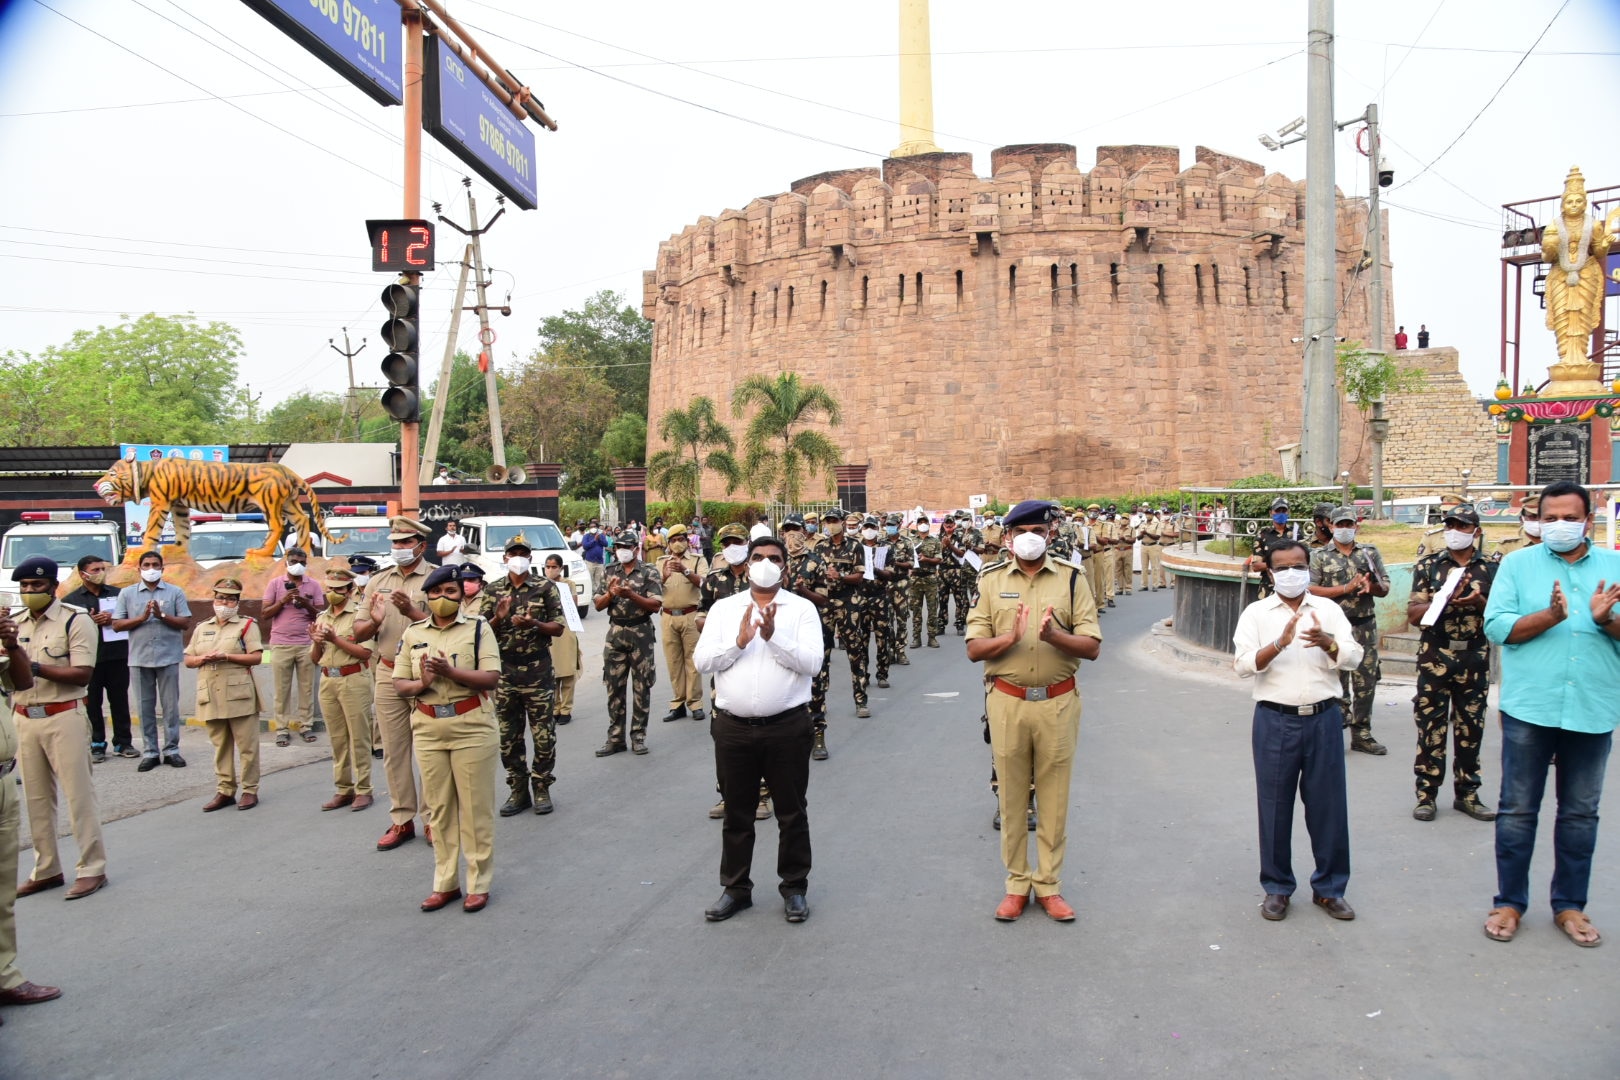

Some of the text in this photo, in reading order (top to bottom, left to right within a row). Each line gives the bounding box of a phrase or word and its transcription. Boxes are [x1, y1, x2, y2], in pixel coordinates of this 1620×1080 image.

[343, 0, 385, 64] 97811
[479, 113, 505, 161] 97866
[506, 140, 529, 181] 97811
[381, 227, 429, 265] 12
